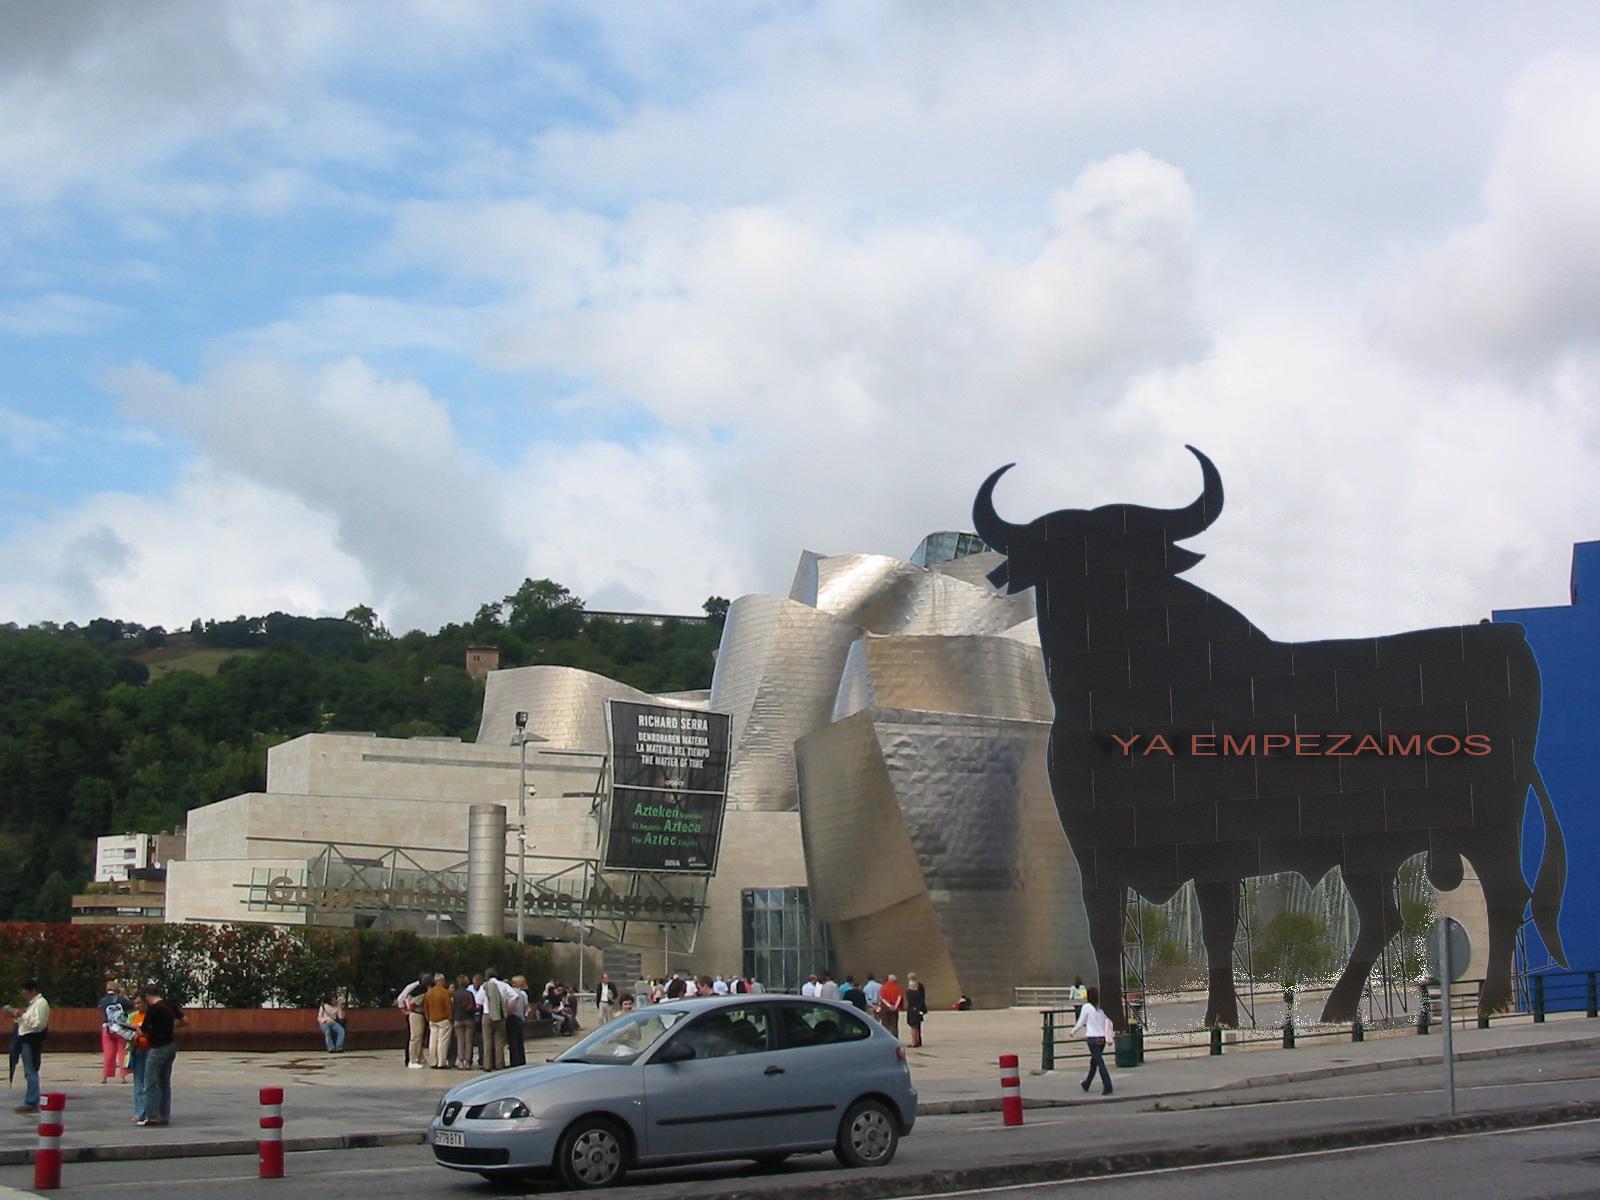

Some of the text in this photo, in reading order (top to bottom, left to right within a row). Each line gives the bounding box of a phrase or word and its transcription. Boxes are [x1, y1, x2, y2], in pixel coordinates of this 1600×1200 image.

[638, 714, 708, 731] RICHARD SERRA
[681, 735, 709, 746] MATERIA
[635, 743, 710, 758] LA MATERIA DEL TIEMPO
[641, 755, 655, 765] THE
[655, 757, 679, 768] MATTER
[679, 758, 688, 768] OF
[634, 803, 679, 819] Azteken
[663, 819, 702, 833] Azteca
[643, 832, 677, 846] Aztec
